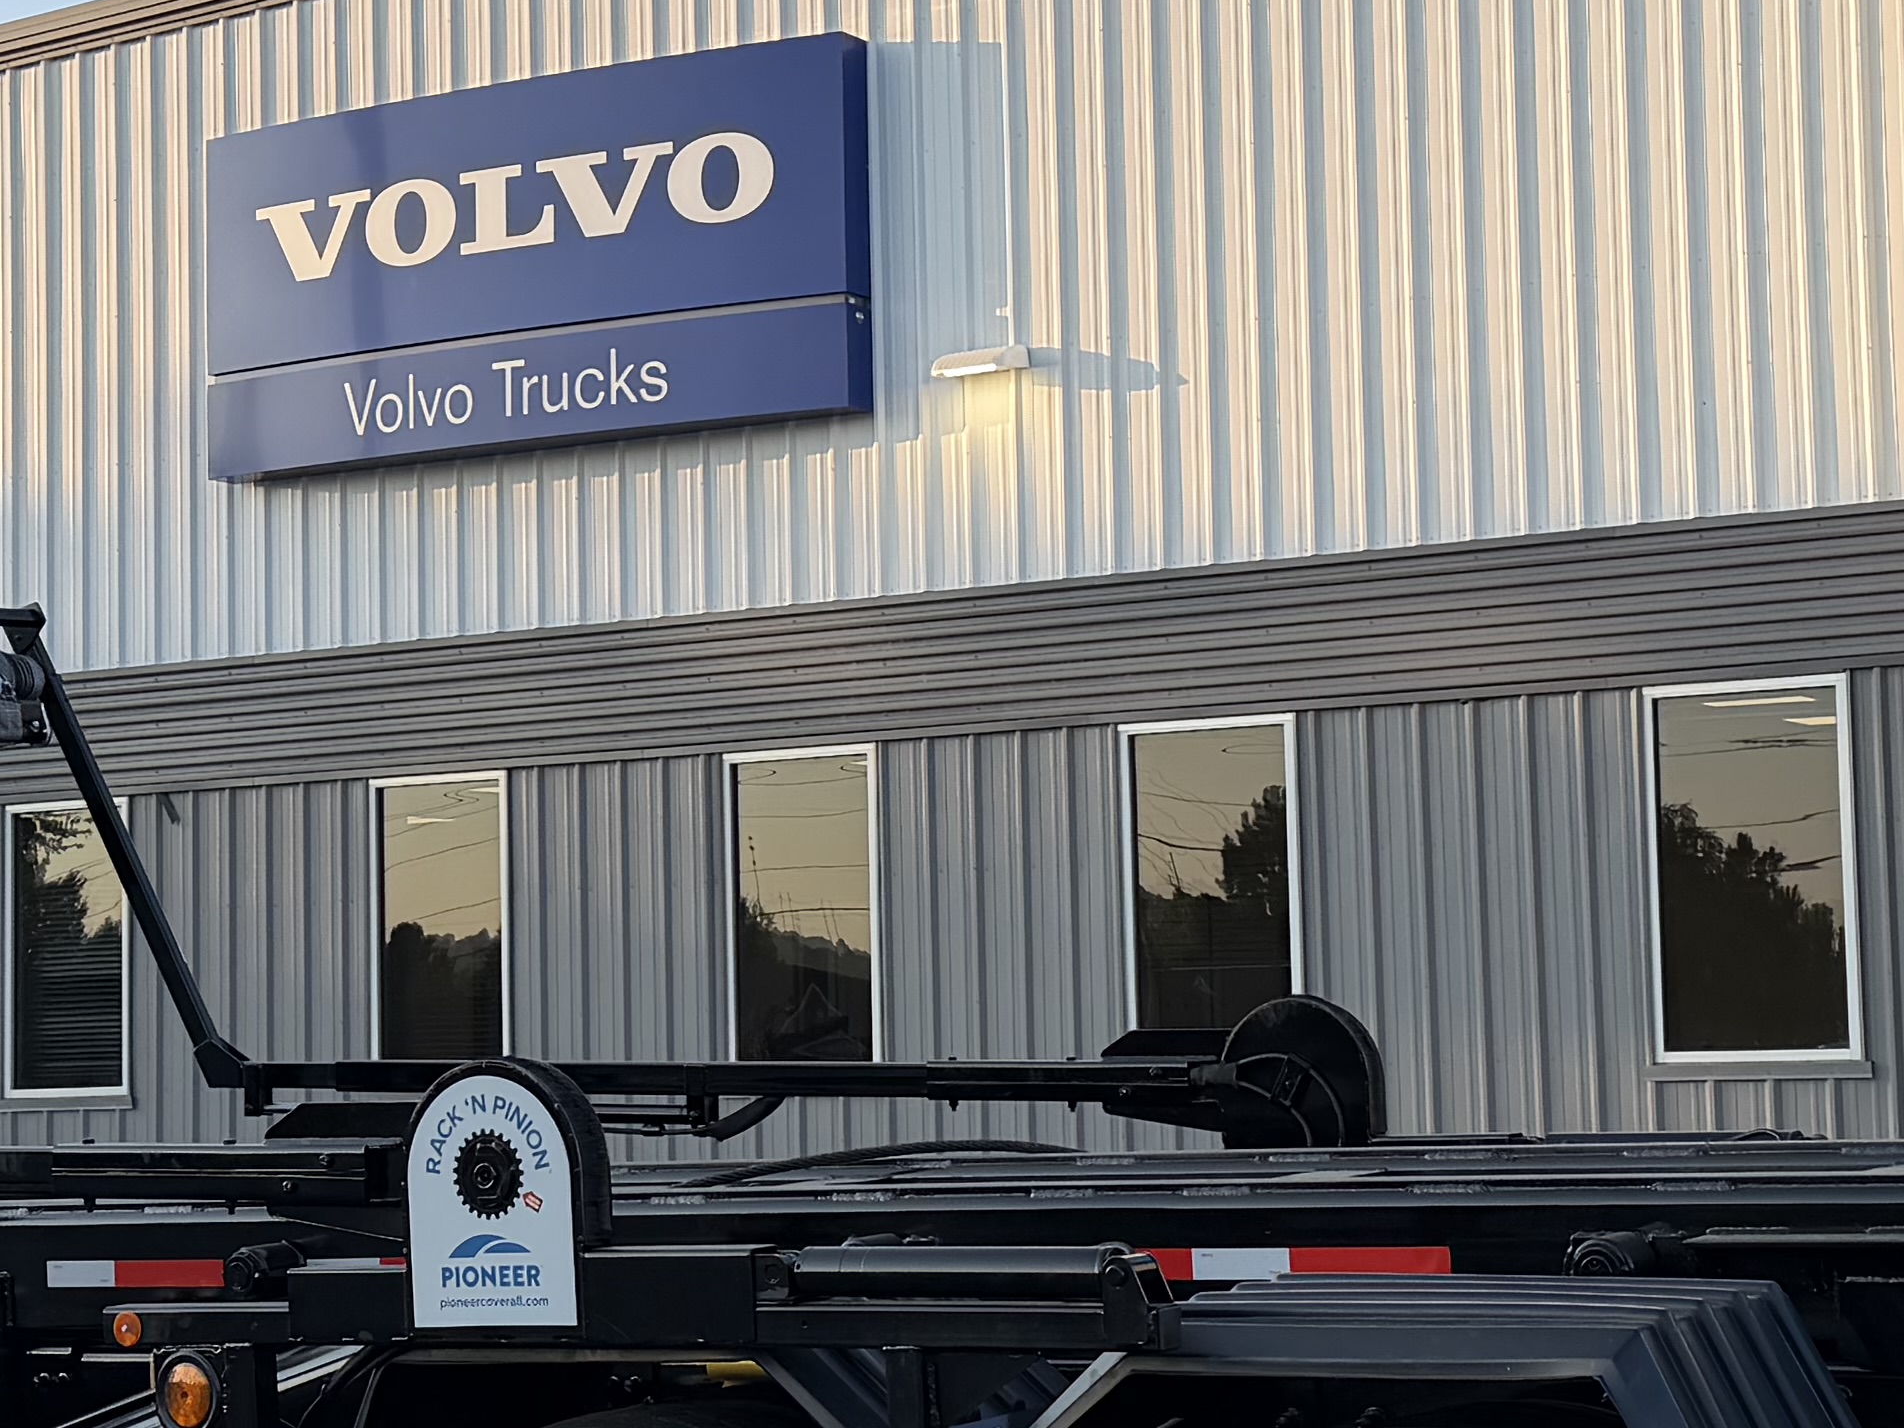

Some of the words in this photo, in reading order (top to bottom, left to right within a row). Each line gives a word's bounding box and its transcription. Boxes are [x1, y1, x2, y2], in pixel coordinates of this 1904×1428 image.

[255, 132, 775, 282] VOLVO
[344, 374, 474, 437] Volvo
[492, 348, 669, 418] Trucks
[425, 1105, 464, 1175] RACK
[492, 1095, 550, 1171] PINION
[440, 1295, 549, 1310] pioneercoverall.com
[441, 1264, 541, 1288] PIONEER
